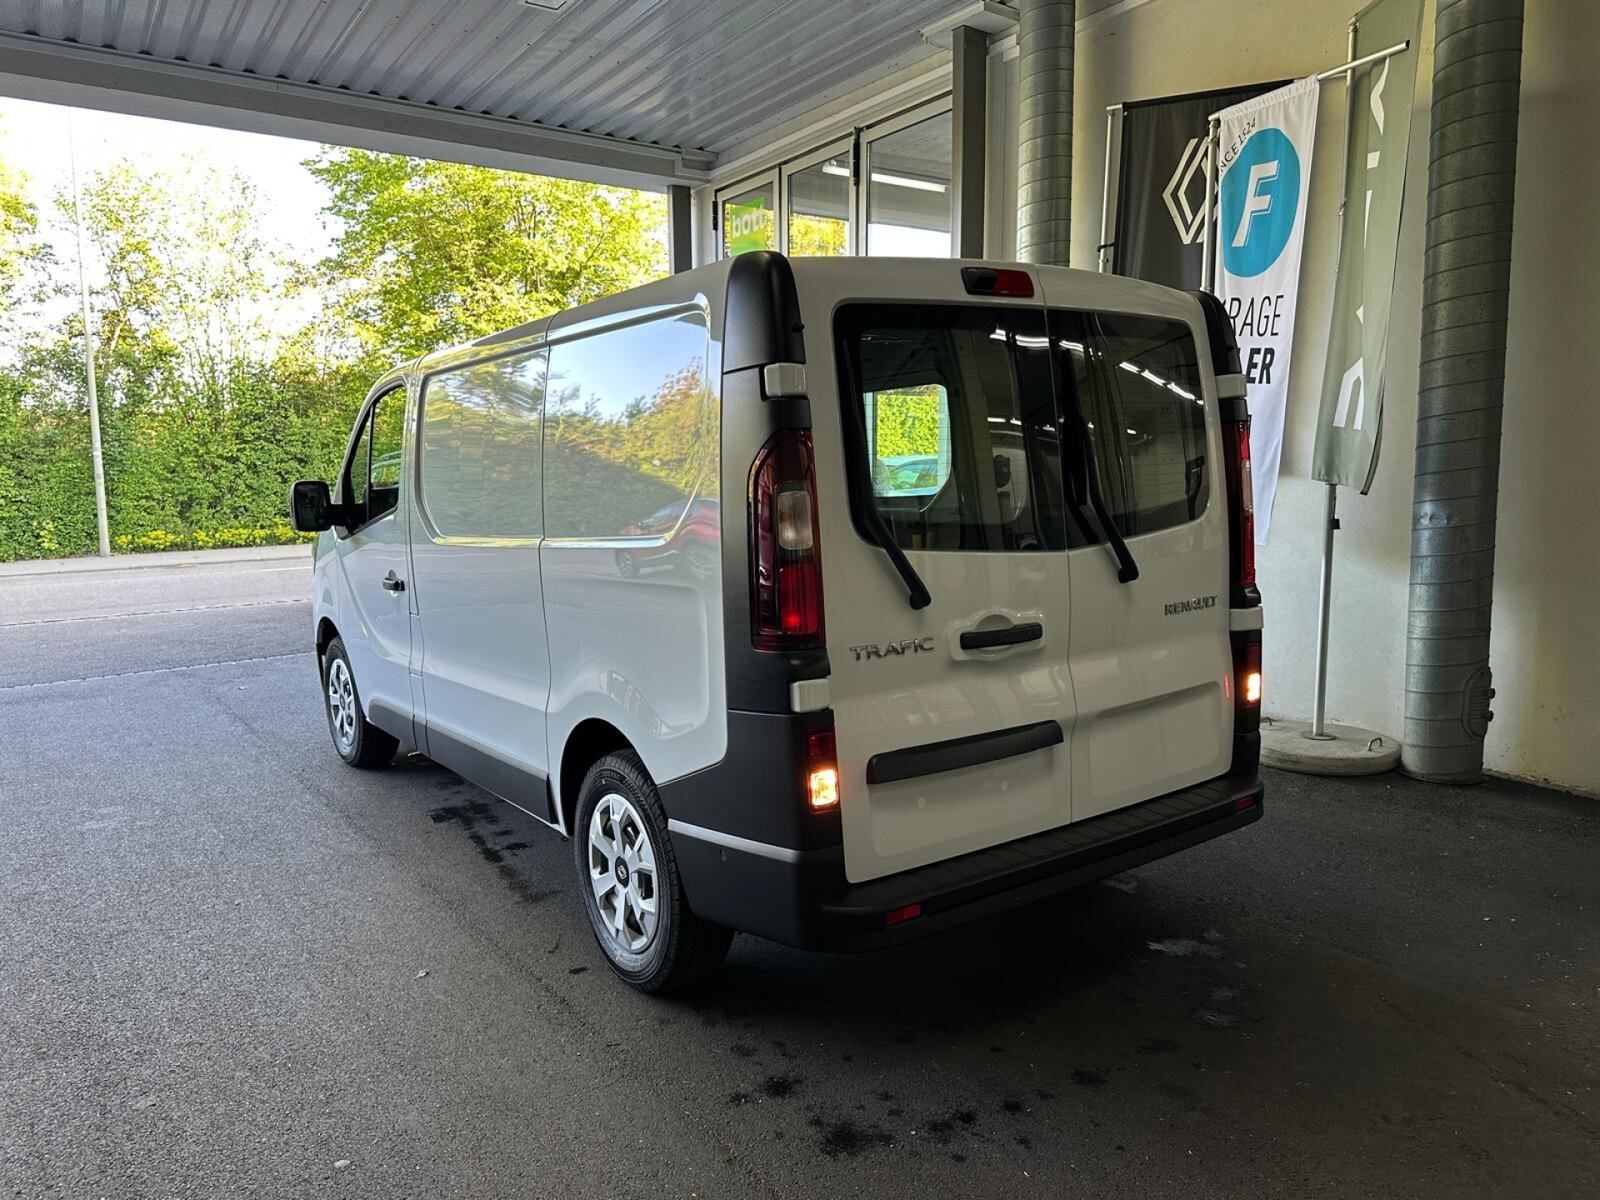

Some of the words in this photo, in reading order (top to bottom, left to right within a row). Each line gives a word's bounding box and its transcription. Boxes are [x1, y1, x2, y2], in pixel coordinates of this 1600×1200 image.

[1231, 160, 1280, 248] F
[1223, 294, 1284, 337] RAGE
[1238, 346, 1276, 385] ER
[1164, 595, 1218, 616] RENAULT
[849, 637, 935, 661] TRAFIC
